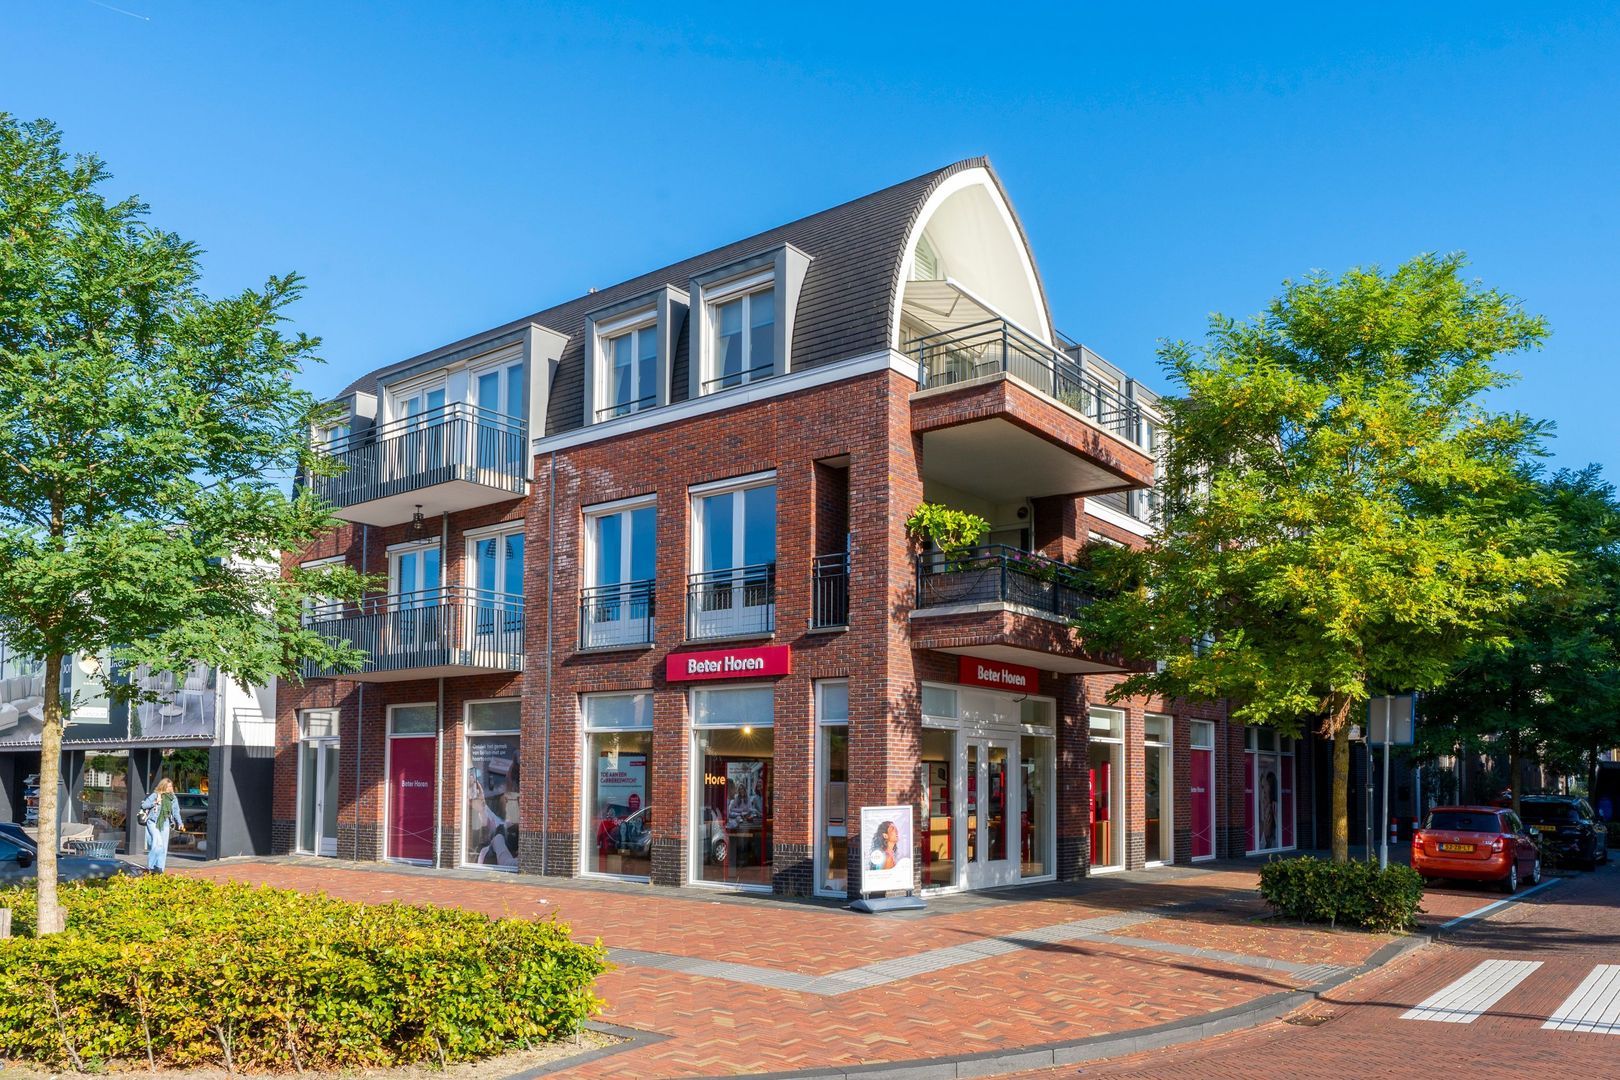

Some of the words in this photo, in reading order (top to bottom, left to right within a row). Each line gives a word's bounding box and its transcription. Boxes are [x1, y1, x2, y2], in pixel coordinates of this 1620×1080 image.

[687, 658, 721, 674] Beter
[724, 656, 764, 672] Horen
[977, 664, 1001, 683] Beter
[1001, 669, 1026, 686] Horen
